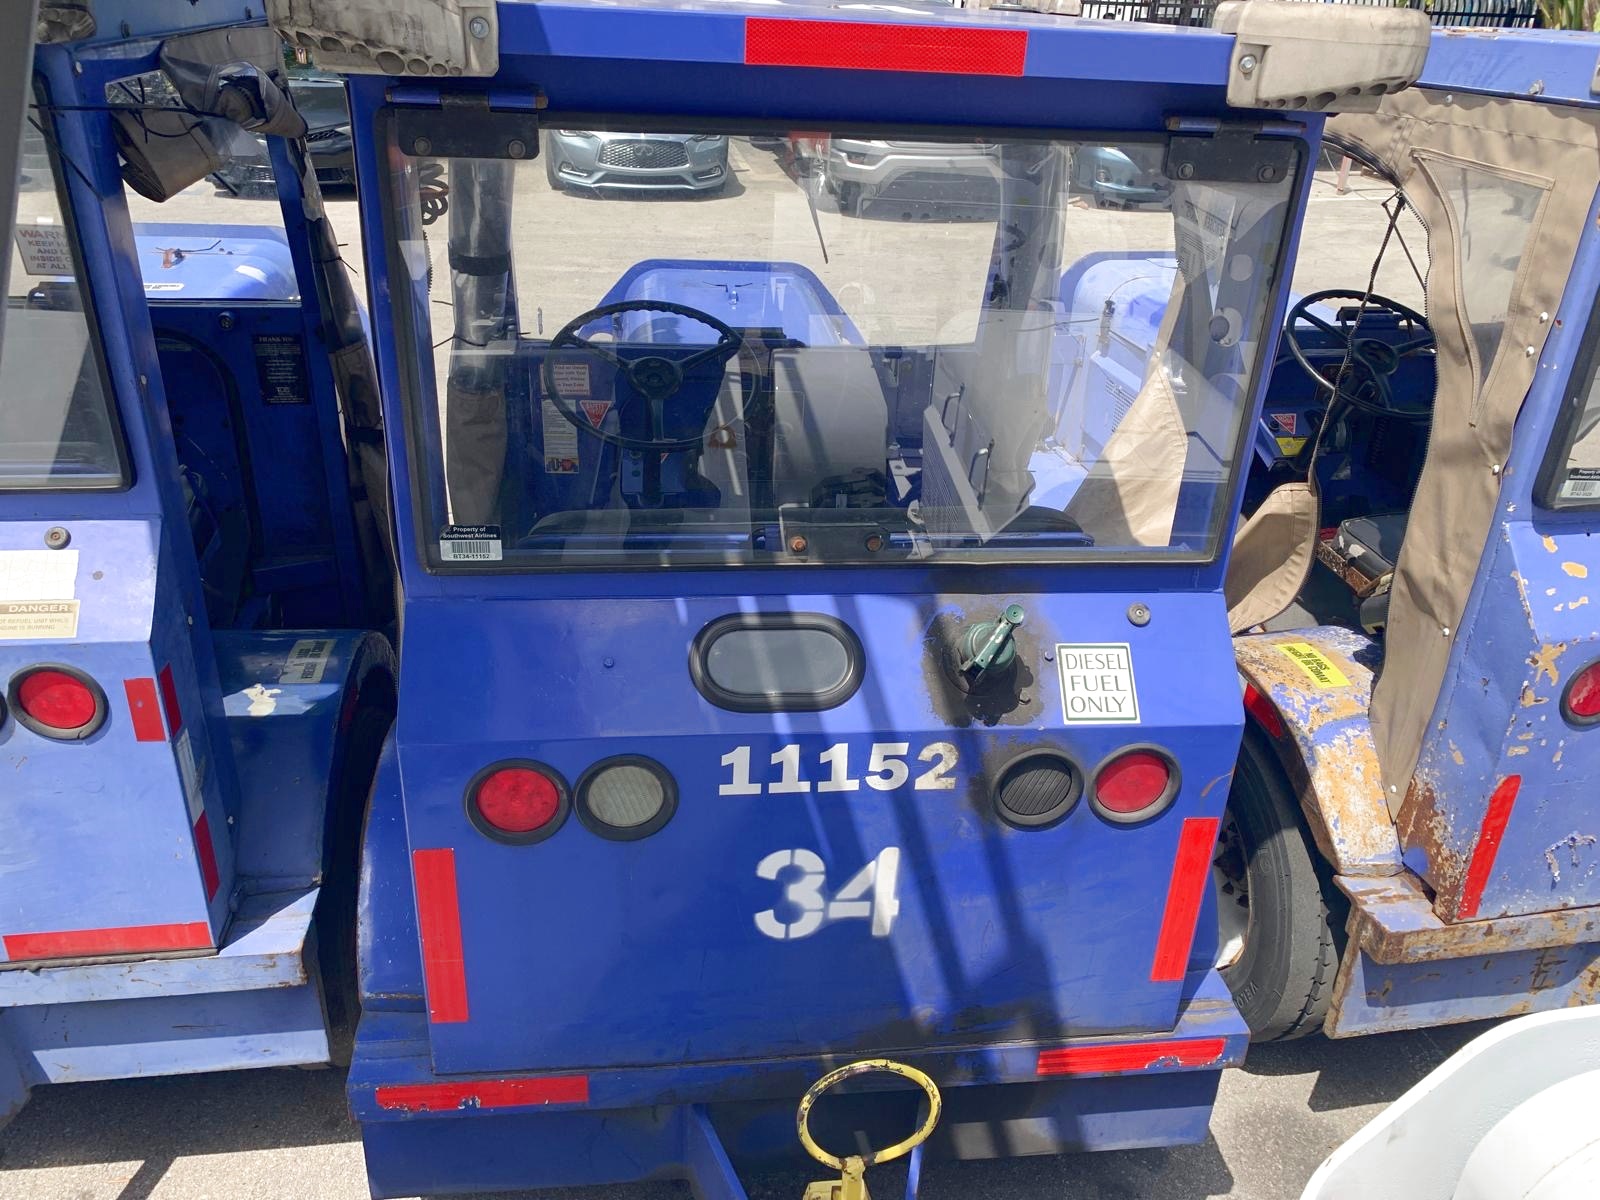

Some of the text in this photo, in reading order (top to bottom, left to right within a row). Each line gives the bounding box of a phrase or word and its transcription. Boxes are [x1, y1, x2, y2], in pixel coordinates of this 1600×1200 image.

[8, 604, 73, 613] DANGER
[1065, 653, 1128, 670] DIESEL
[1070, 675, 1128, 692] FUEL
[1070, 696, 1126, 713] ONLY
[719, 742, 959, 796] 11152
[754, 846, 900, 940] 34
